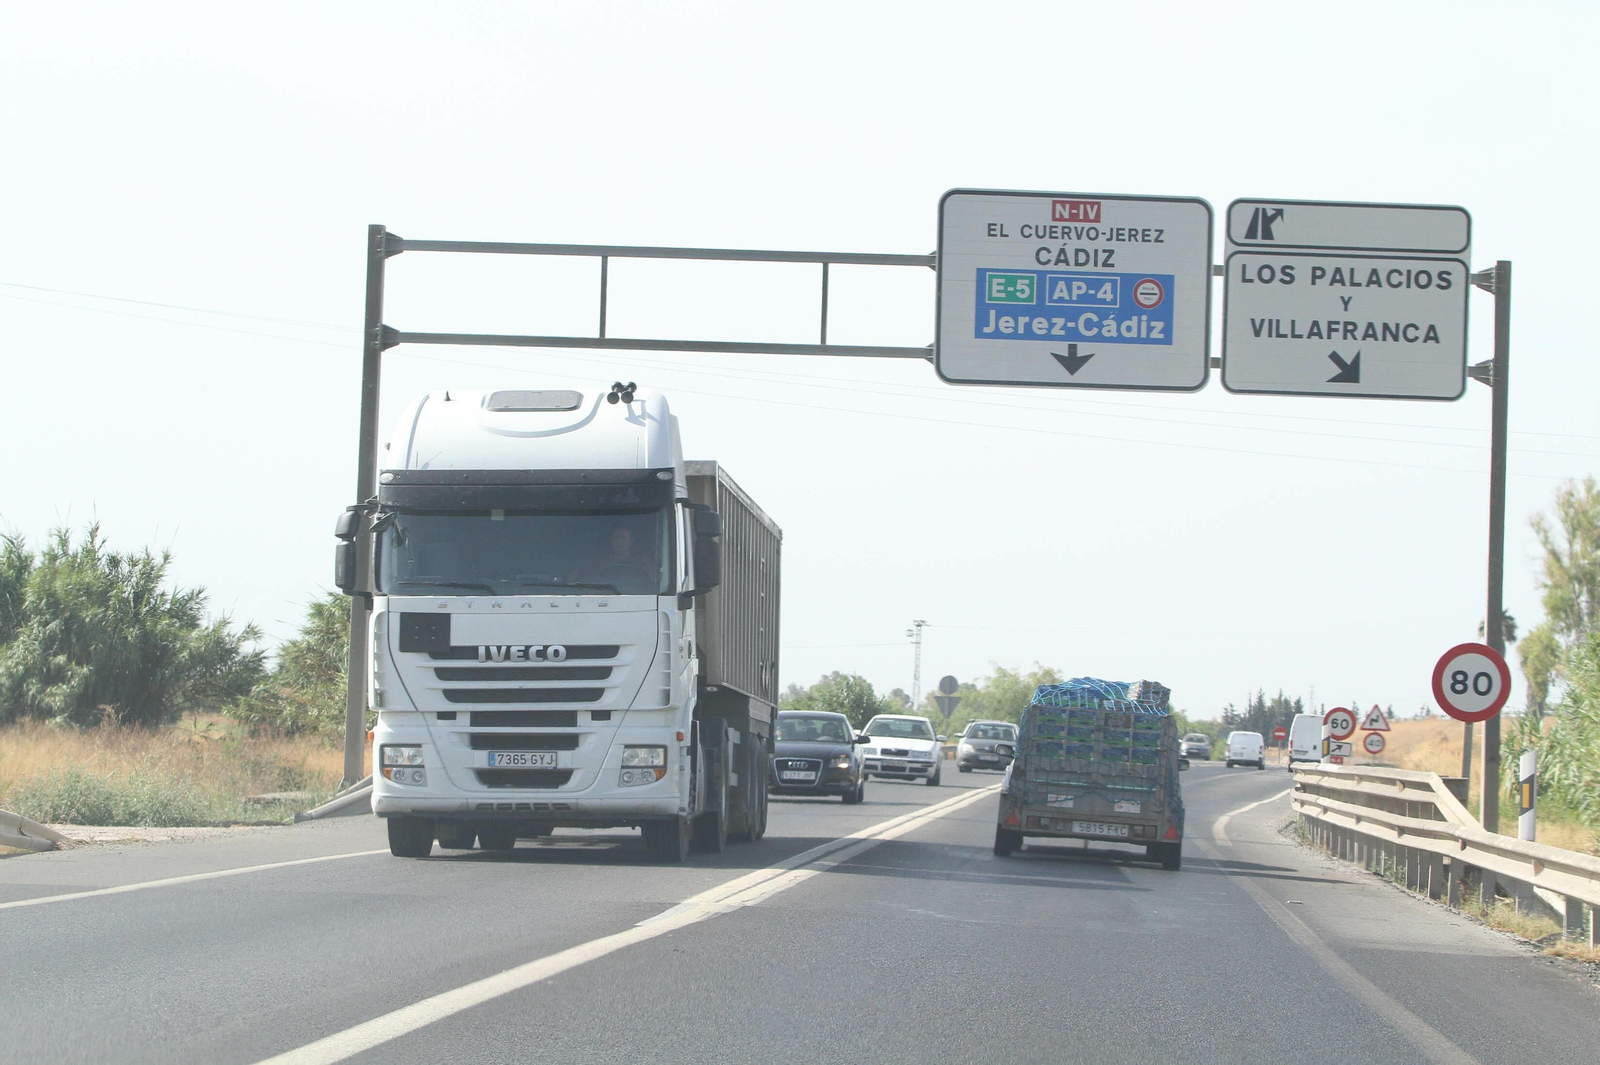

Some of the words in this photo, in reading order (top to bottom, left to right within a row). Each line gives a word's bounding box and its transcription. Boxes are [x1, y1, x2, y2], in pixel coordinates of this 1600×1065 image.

[1055, 203, 1099, 220] N-IV
[987, 223, 1009, 238] EL
[1020, 224, 1165, 243] CUERVO-JEREZ
[1035, 243, 1115, 268] CÁDIZ
[1241, 264, 1296, 285] LOS
[1311, 266, 1453, 290] PALACIOS
[991, 278, 1031, 299] E-5
[1052, 280, 1114, 302] AP-4
[1340, 296, 1353, 312] Y
[983, 309, 1165, 339] Jerez-Cádiz
[1250, 318, 1440, 344] VILLAFRANCA
[437, 600, 608, 609] STRALIS
[478, 645, 567, 663] IVECO
[1450, 670, 1493, 697] 80
[1331, 718, 1349, 730] 60
[497, 754, 527, 765] 7365
[530, 754, 553, 765] GYJ
[1079, 822, 1105, 834] 5815
[1107, 826, 1127, 836] FYC
